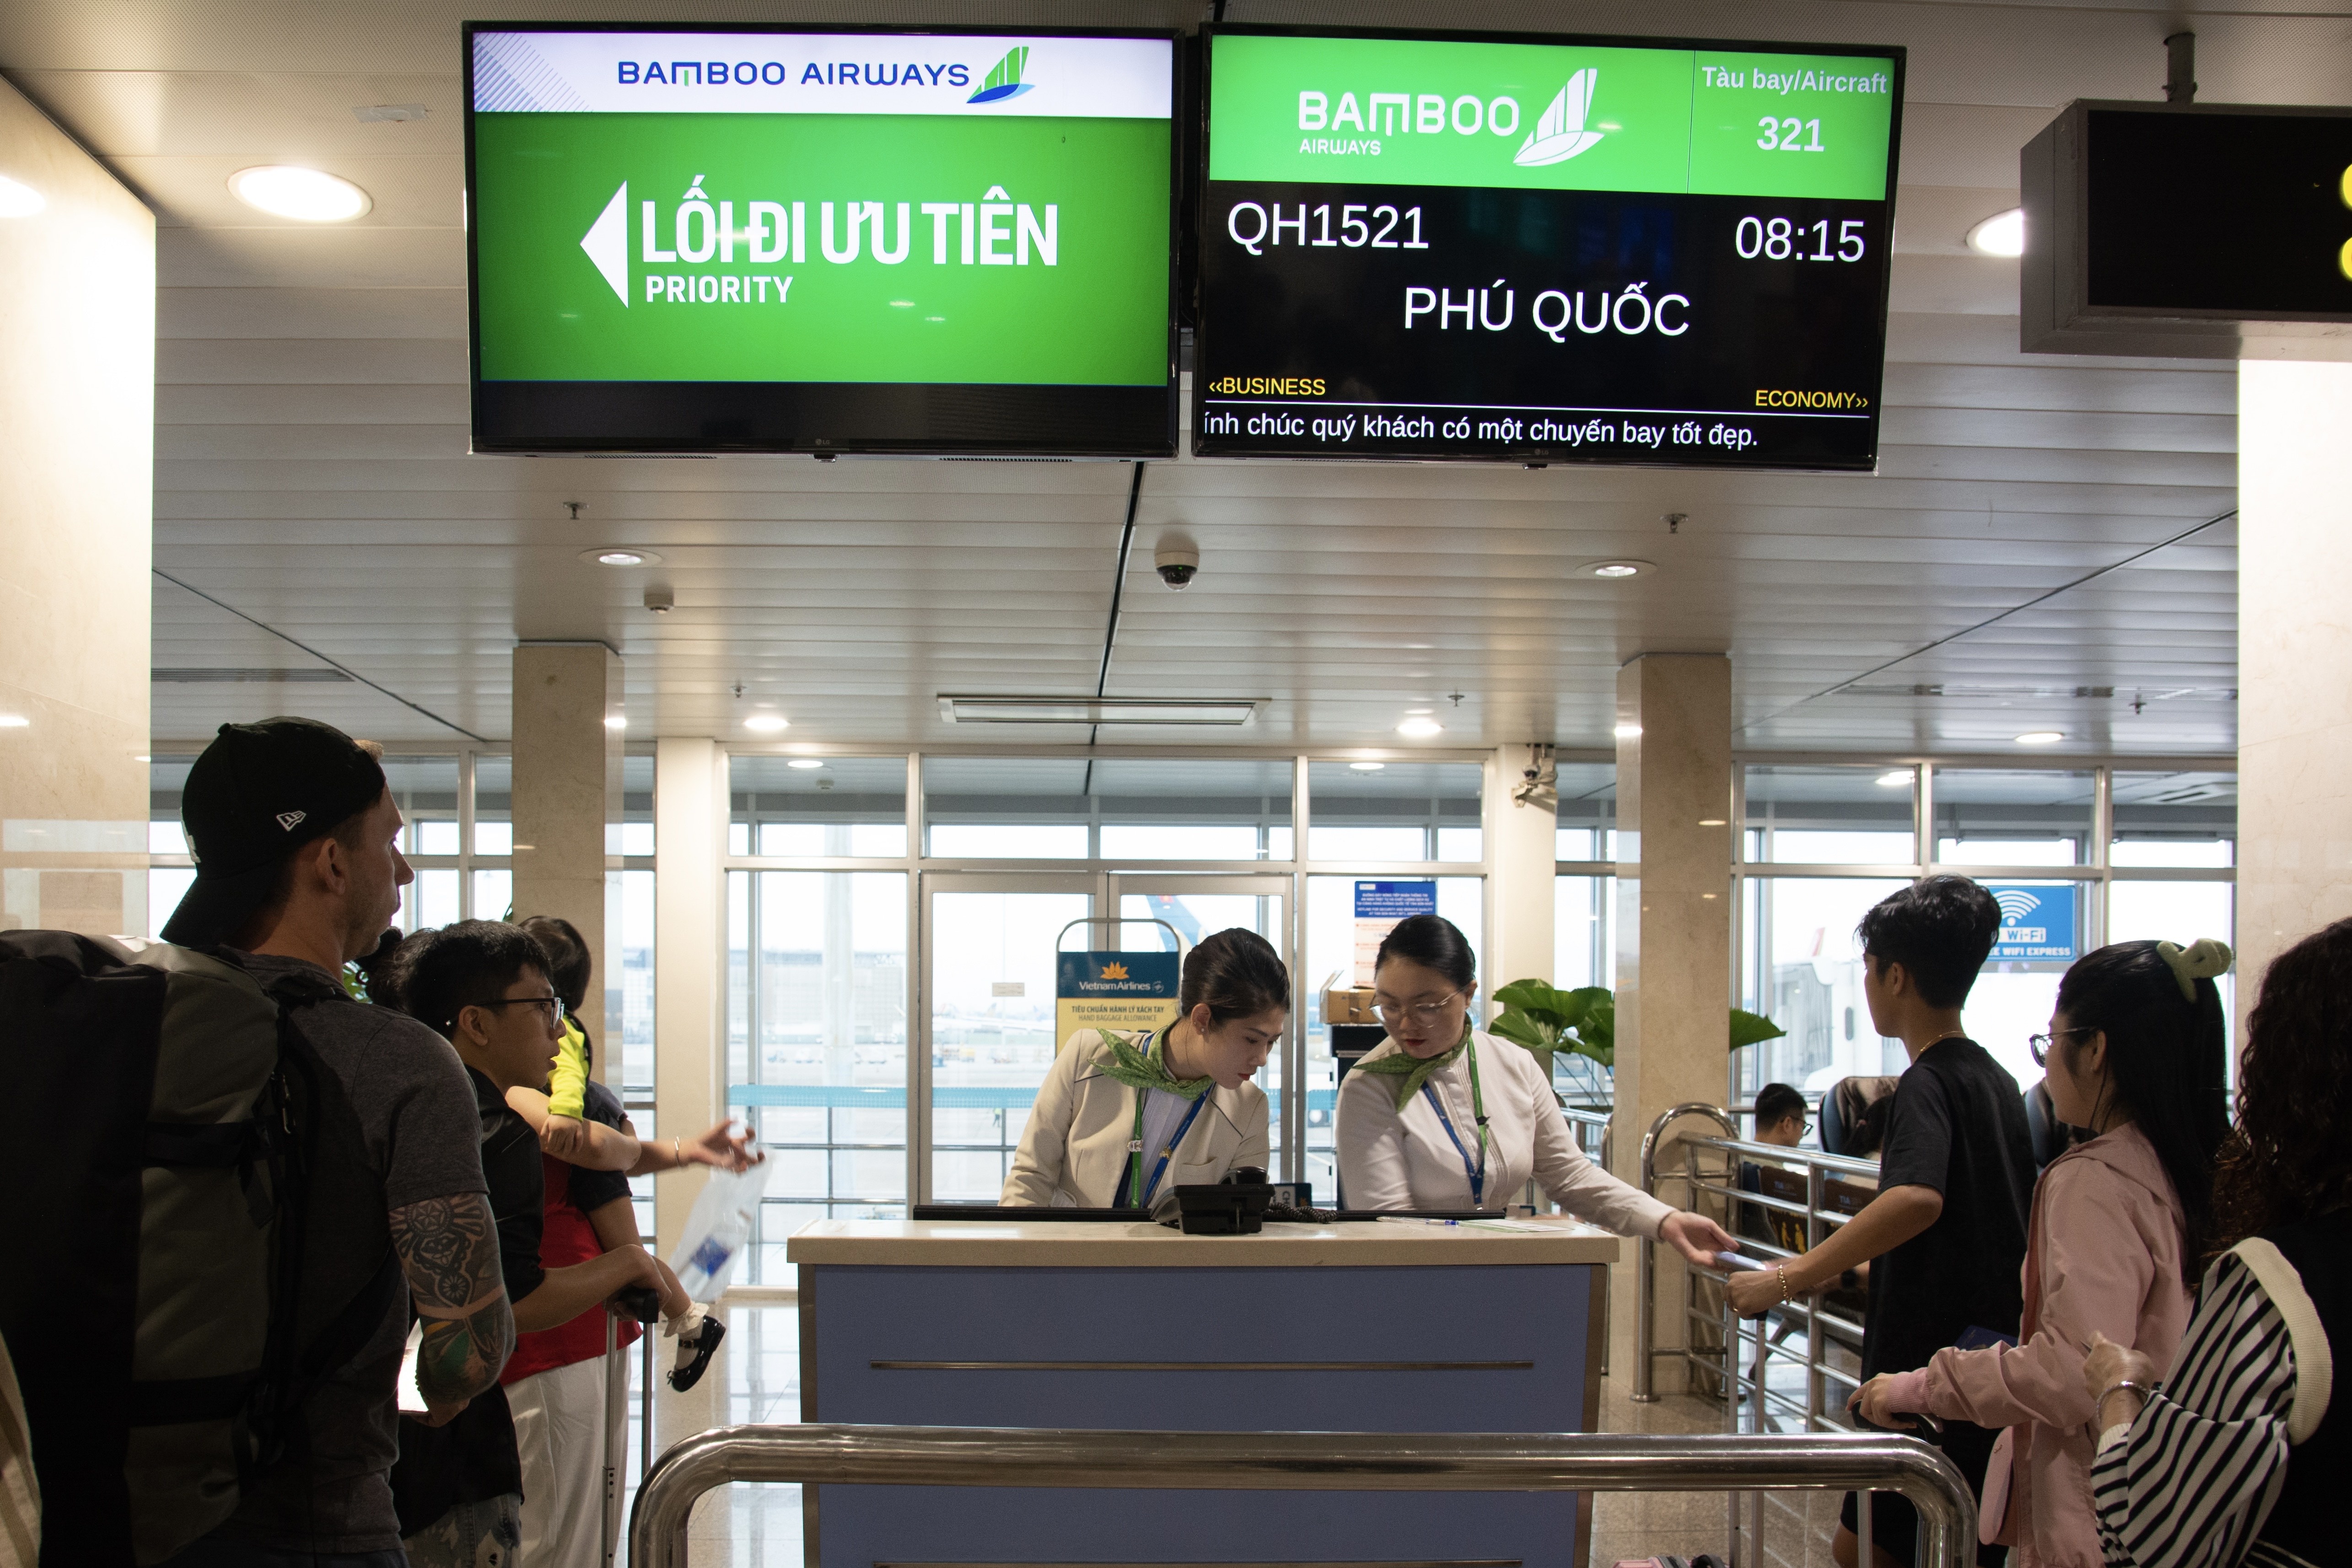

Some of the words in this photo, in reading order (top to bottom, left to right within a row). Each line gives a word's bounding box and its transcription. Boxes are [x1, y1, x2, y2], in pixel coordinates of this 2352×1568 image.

[619, 61, 785, 87] BAMBOO
[801, 63, 969, 86] AIRWAYS
[1701, 66, 1744, 88] Tàu
[1753, 68, 1887, 95] bay/Aircraft
[1298, 91, 1520, 136] BAMBOO
[1299, 138, 1381, 156] AIRWAYS
[1756, 116, 1825, 152] 321
[642, 175, 733, 264] LỐI
[745, 201, 805, 263] ĐI
[821, 200, 910, 265] ƯU
[921, 185, 1058, 266] TIÊN
[1228, 202, 1429, 255] QH1521
[1735, 216, 1865, 263] 08:15
[646, 275, 793, 303] PRIORITY
[1405, 279, 1513, 331] PHÚ
[1533, 281, 1690, 343] QUỐC
[1248, 413, 1304, 436] chúc
[1312, 414, 1356, 442] quý
[1363, 415, 1434, 438] khách
[1442, 416, 1470, 439] có
[1479, 418, 1523, 444] một
[1530, 419, 1615, 447] chuyến
[1623, 420, 1666, 448] bay
[1672, 421, 1702, 444] tốt
[1708, 423, 1757, 451] đẹp.
[2002, 947, 2024, 956] WIFI
[2027, 947, 2072, 956] EXPRESS
